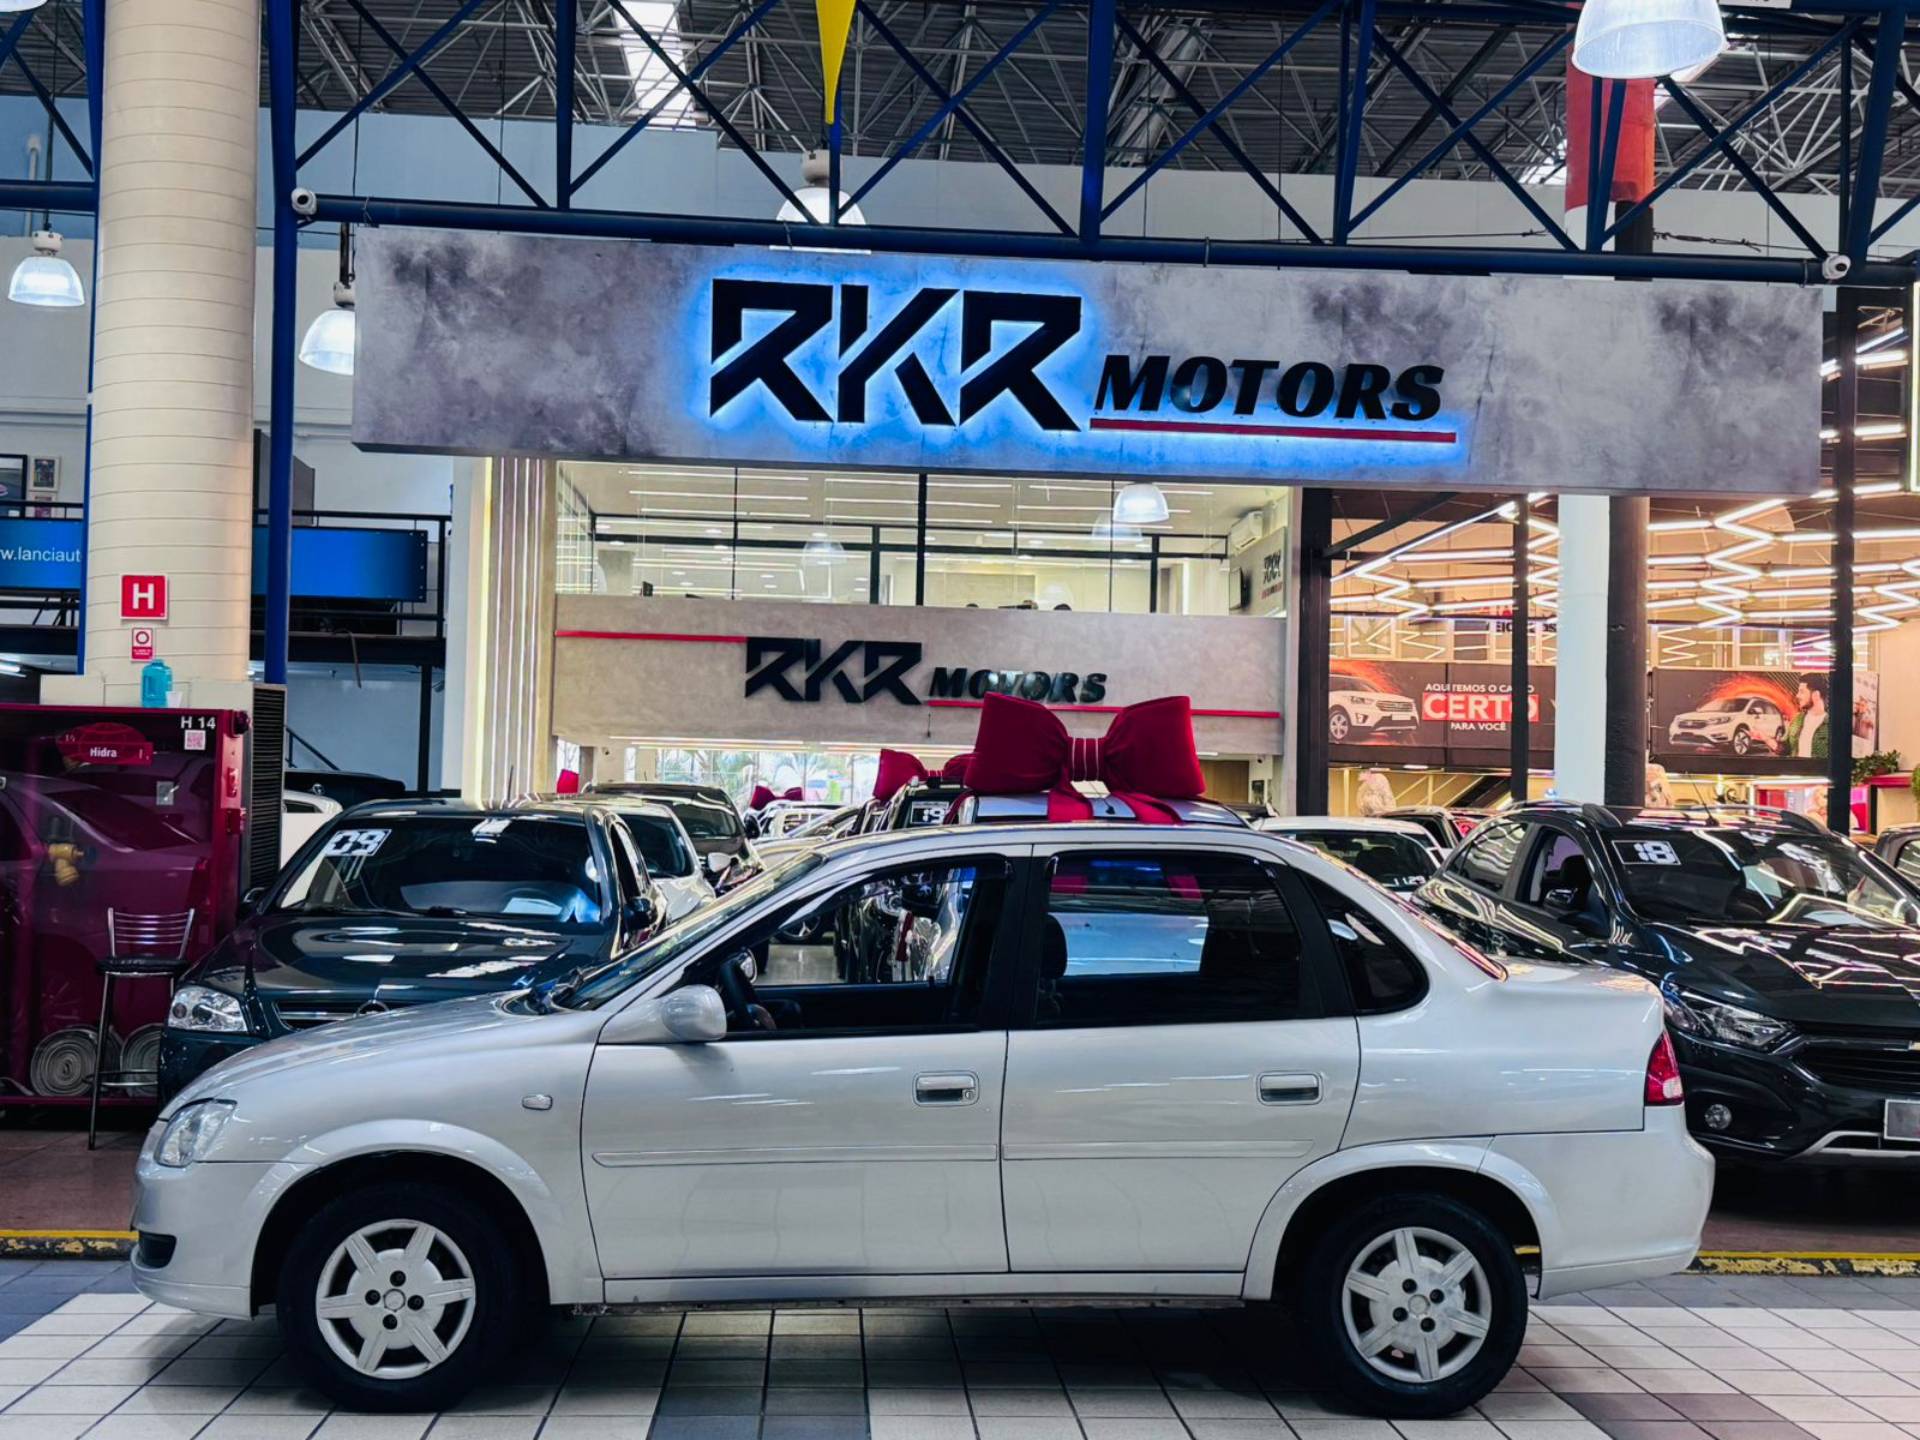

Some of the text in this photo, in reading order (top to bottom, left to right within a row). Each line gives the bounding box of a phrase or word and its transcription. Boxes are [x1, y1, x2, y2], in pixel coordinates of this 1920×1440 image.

[711, 279, 1445, 431] RKR MOTORS
[132, 583, 154, 610] H
[745, 637, 1108, 705] RKR MOTORS
[1425, 683, 1450, 691] AQUI
[1452, 684, 1485, 692] TEMOS
[1499, 685, 1535, 693] CAO
[181, 716, 216, 729] H 14
[1450, 722, 1475, 730] PARA
[90, 747, 118, 758] Hidra
[326, 830, 387, 856] 09
